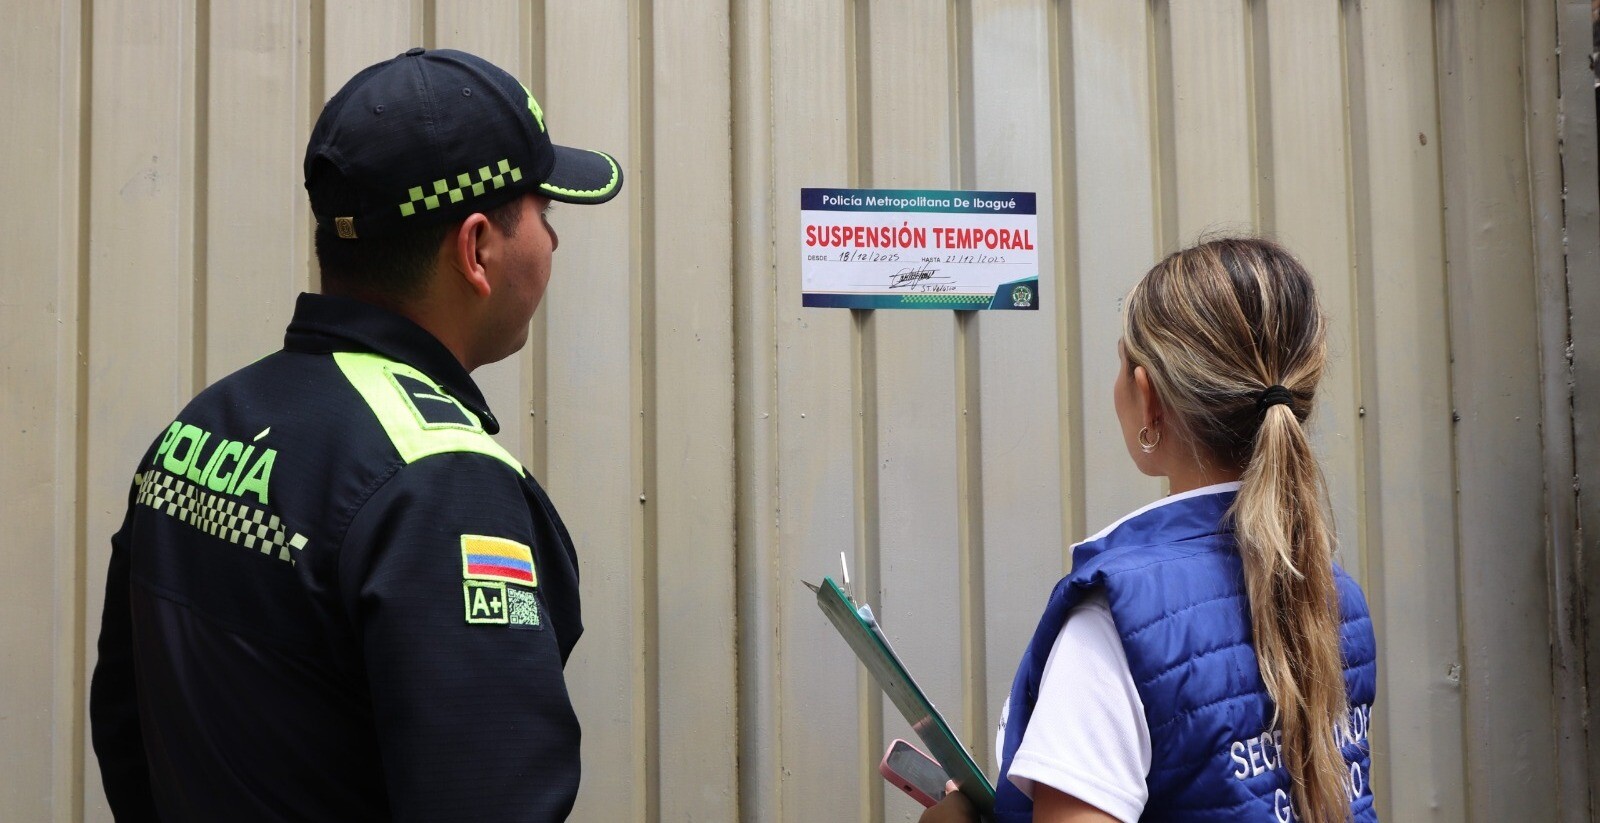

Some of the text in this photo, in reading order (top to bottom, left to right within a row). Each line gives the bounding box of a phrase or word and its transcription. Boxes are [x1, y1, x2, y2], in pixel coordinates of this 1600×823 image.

[822, 194, 1016, 211] Policía Metropolitana De Ibagué
[805, 221, 1034, 250] SUSPENSIÓN TEMPORAL
[153, 420, 277, 505] POLICÍA
[471, 587, 502, 616] A+
